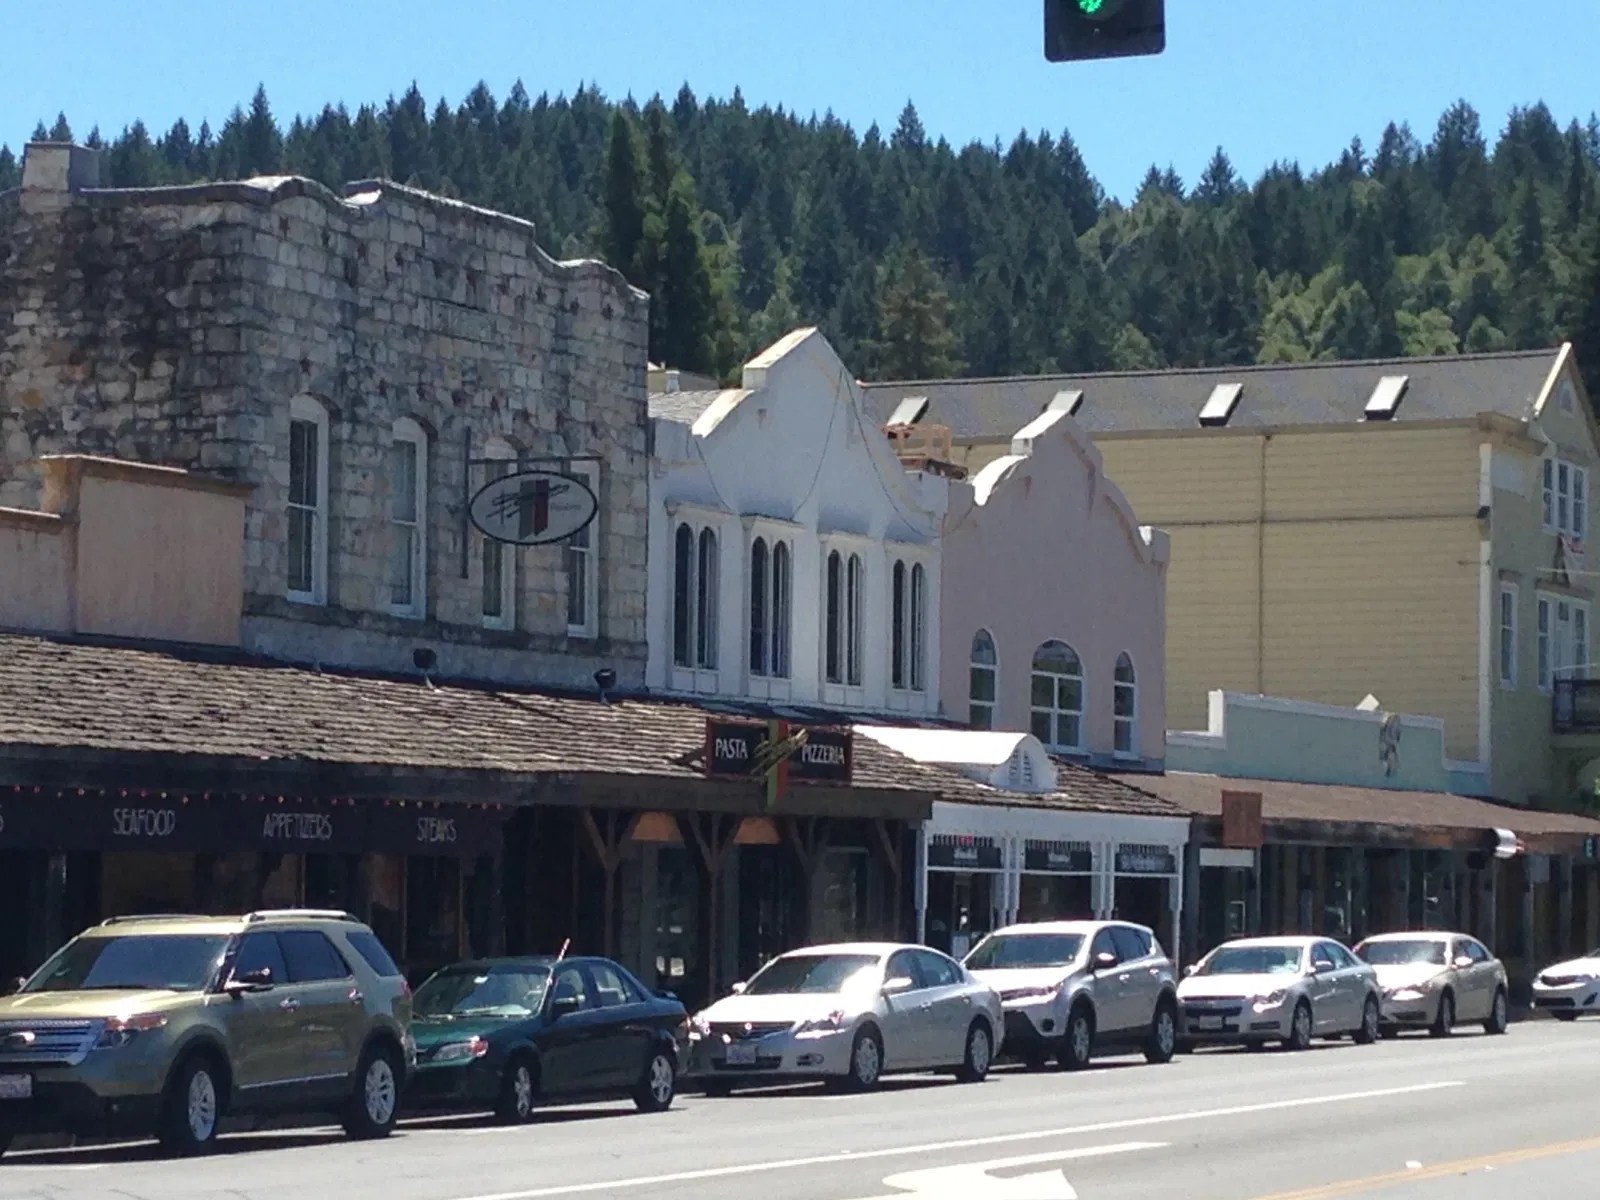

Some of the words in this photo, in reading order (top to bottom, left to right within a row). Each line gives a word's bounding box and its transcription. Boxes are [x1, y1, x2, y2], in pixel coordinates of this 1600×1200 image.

[715, 738, 748, 759] PASTA
[802, 744, 845, 765] PIZZERIA
[112, 808, 176, 836] SEAFOOD
[263, 812, 334, 840] APPETIZERS
[416, 816, 458, 842] STEAKS
